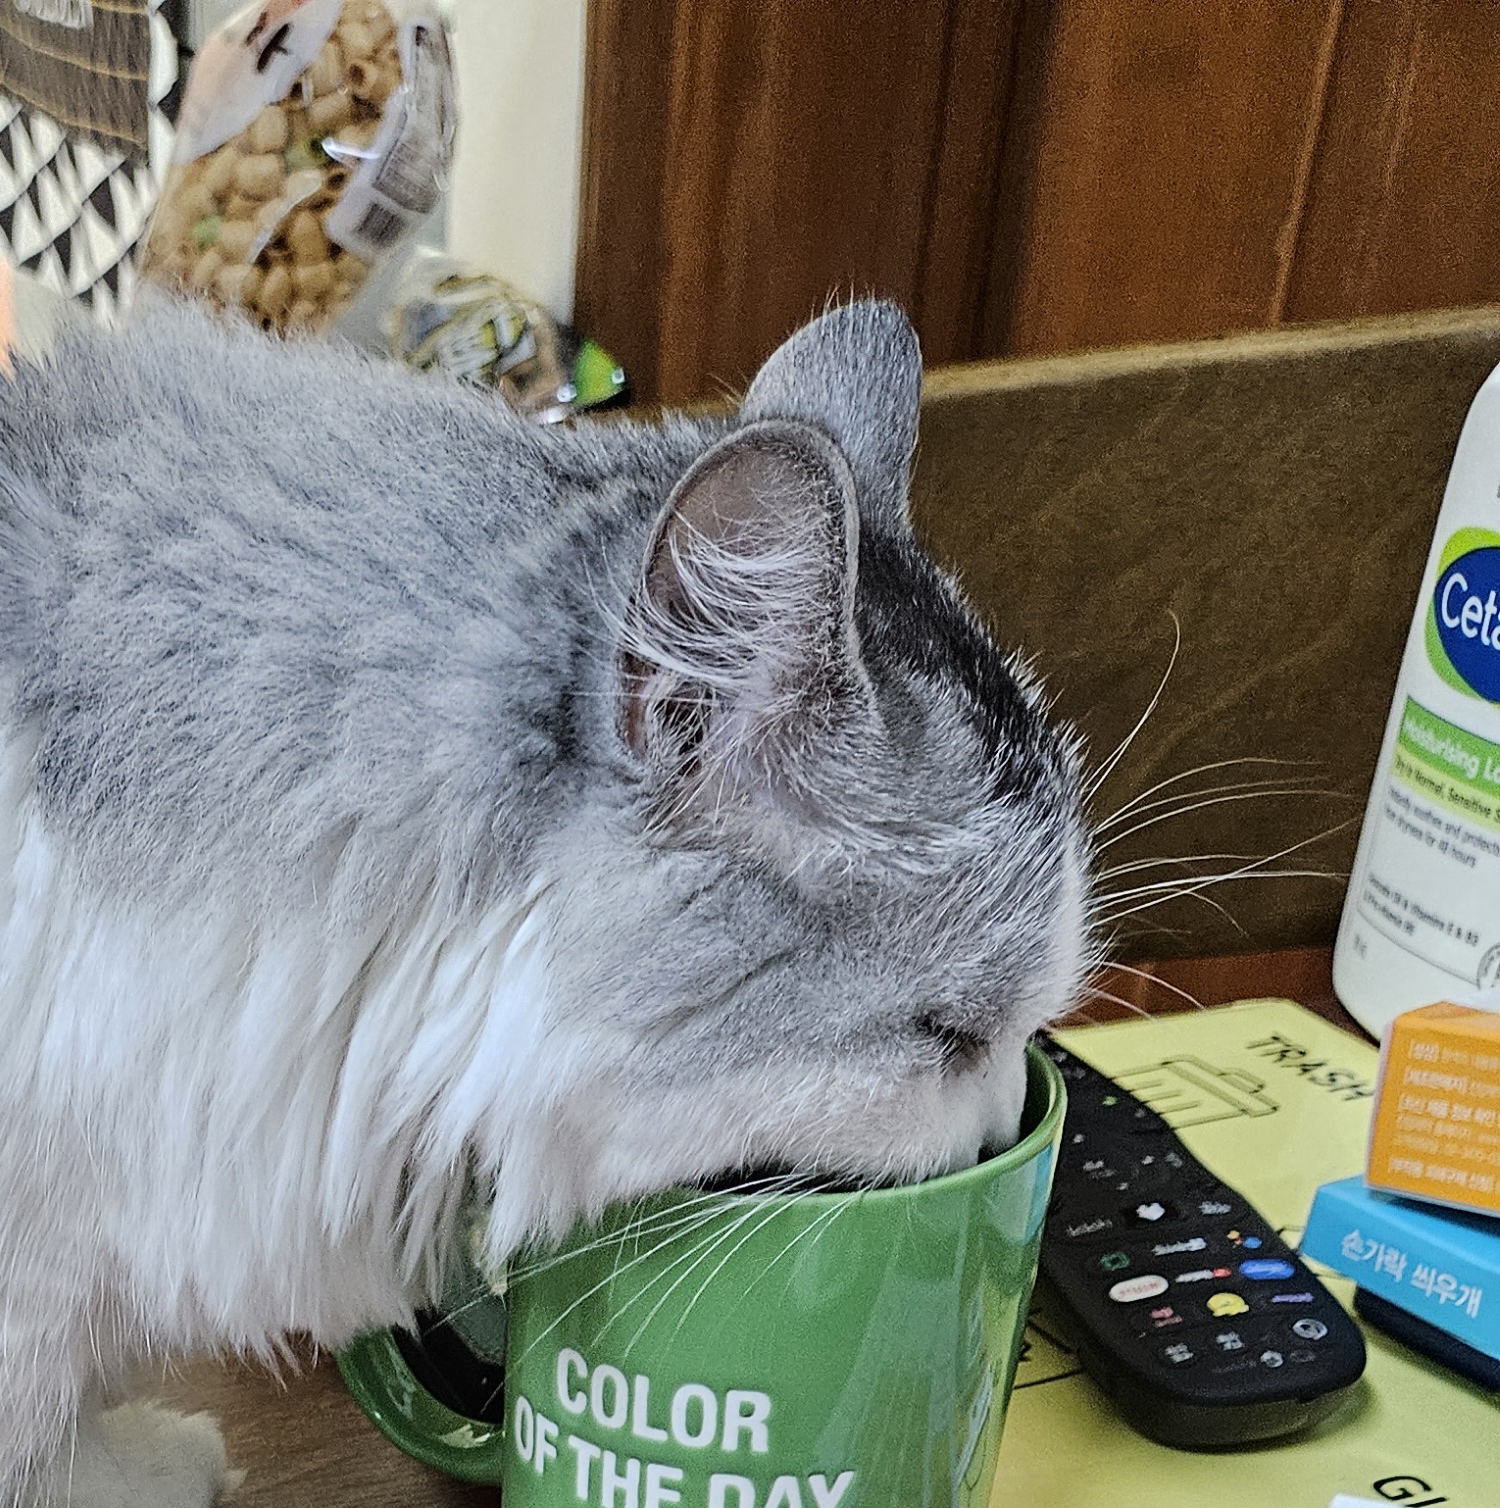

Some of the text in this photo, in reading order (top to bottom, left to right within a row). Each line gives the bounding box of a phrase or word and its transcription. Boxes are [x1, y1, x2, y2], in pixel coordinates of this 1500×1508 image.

[1341, 1228, 1483, 1320] 손가락 씌우개
[515, 1395, 559, 1476] OF
[557, 1348, 771, 1454] COLOR
